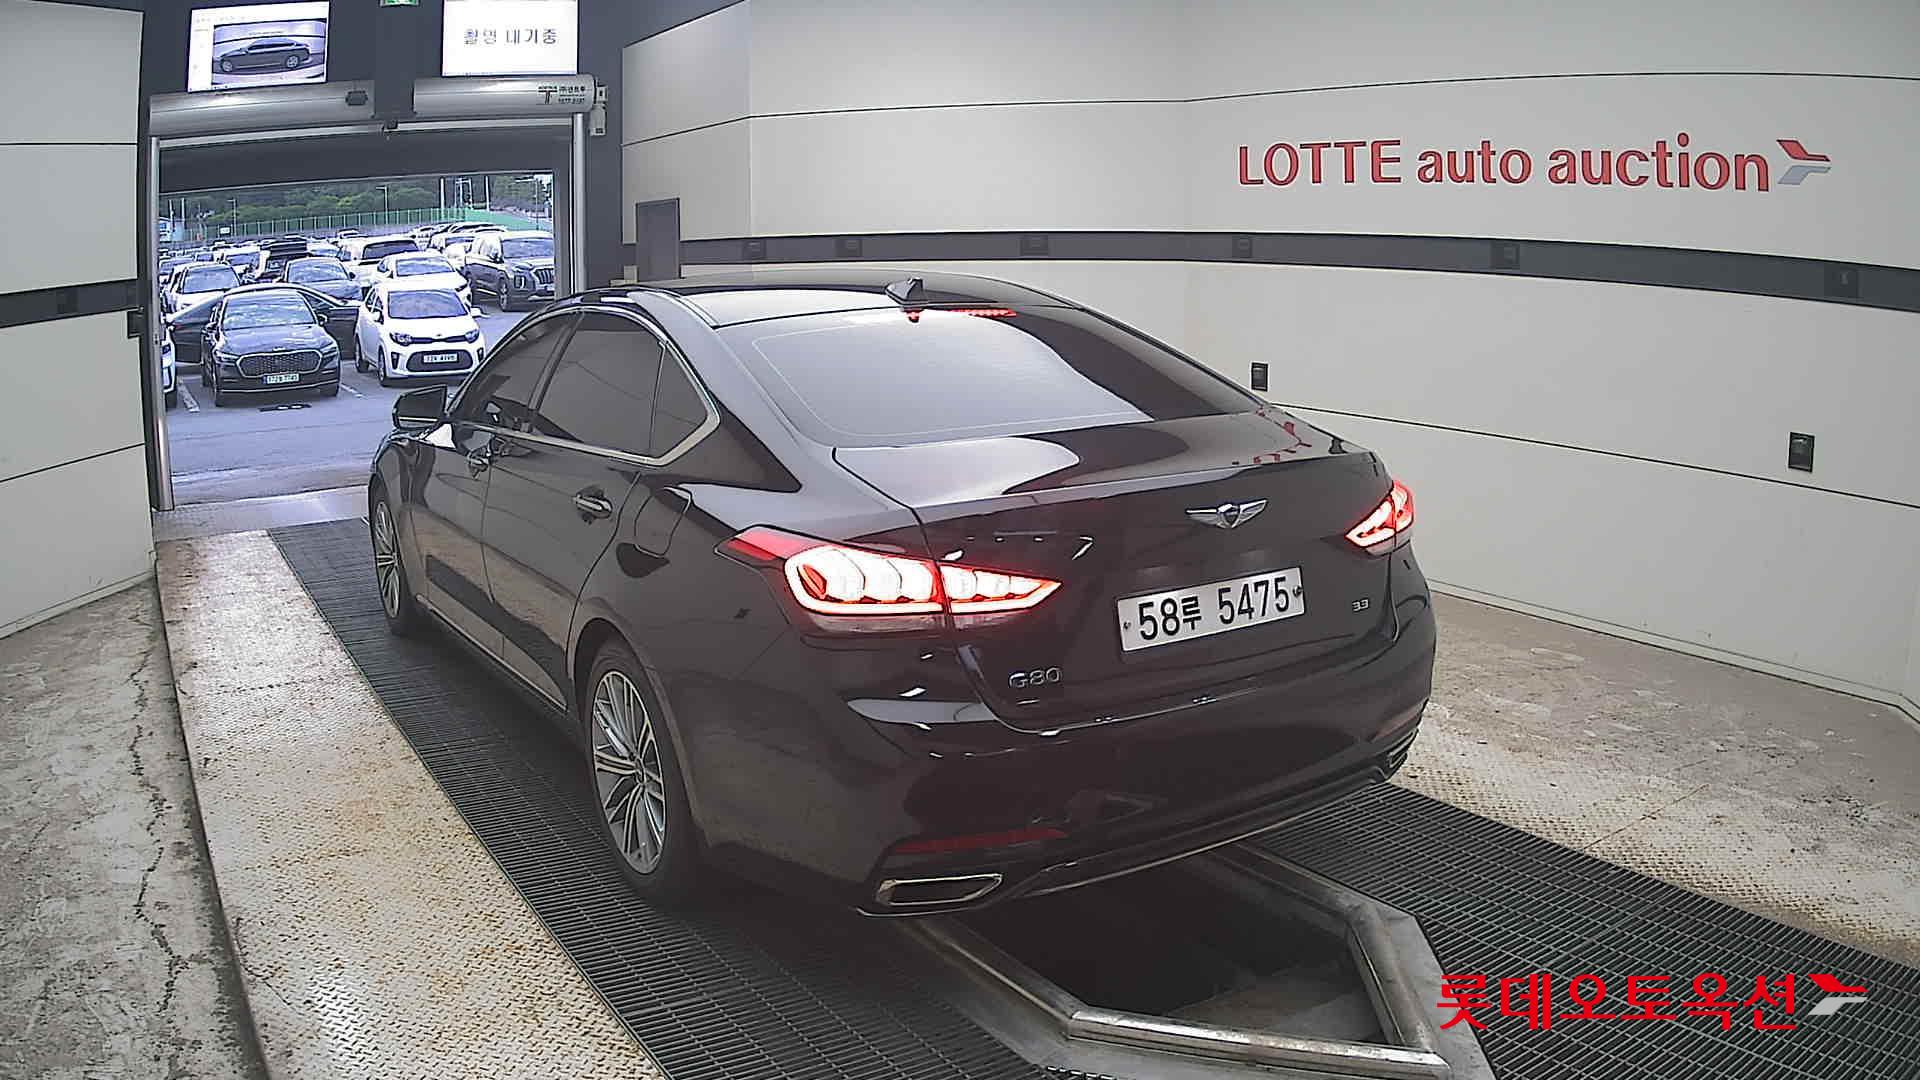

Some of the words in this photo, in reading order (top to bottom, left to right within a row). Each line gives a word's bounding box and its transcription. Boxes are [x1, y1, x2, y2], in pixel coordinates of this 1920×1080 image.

[1239, 140, 1400, 186] LOTTE
[1417, 140, 1533, 184] auto
[1547, 132, 1769, 191] auction
[1138, 596, 1201, 641] 58루
[1217, 576, 1289, 625] 5475
[1008, 667, 1062, 688] G80
